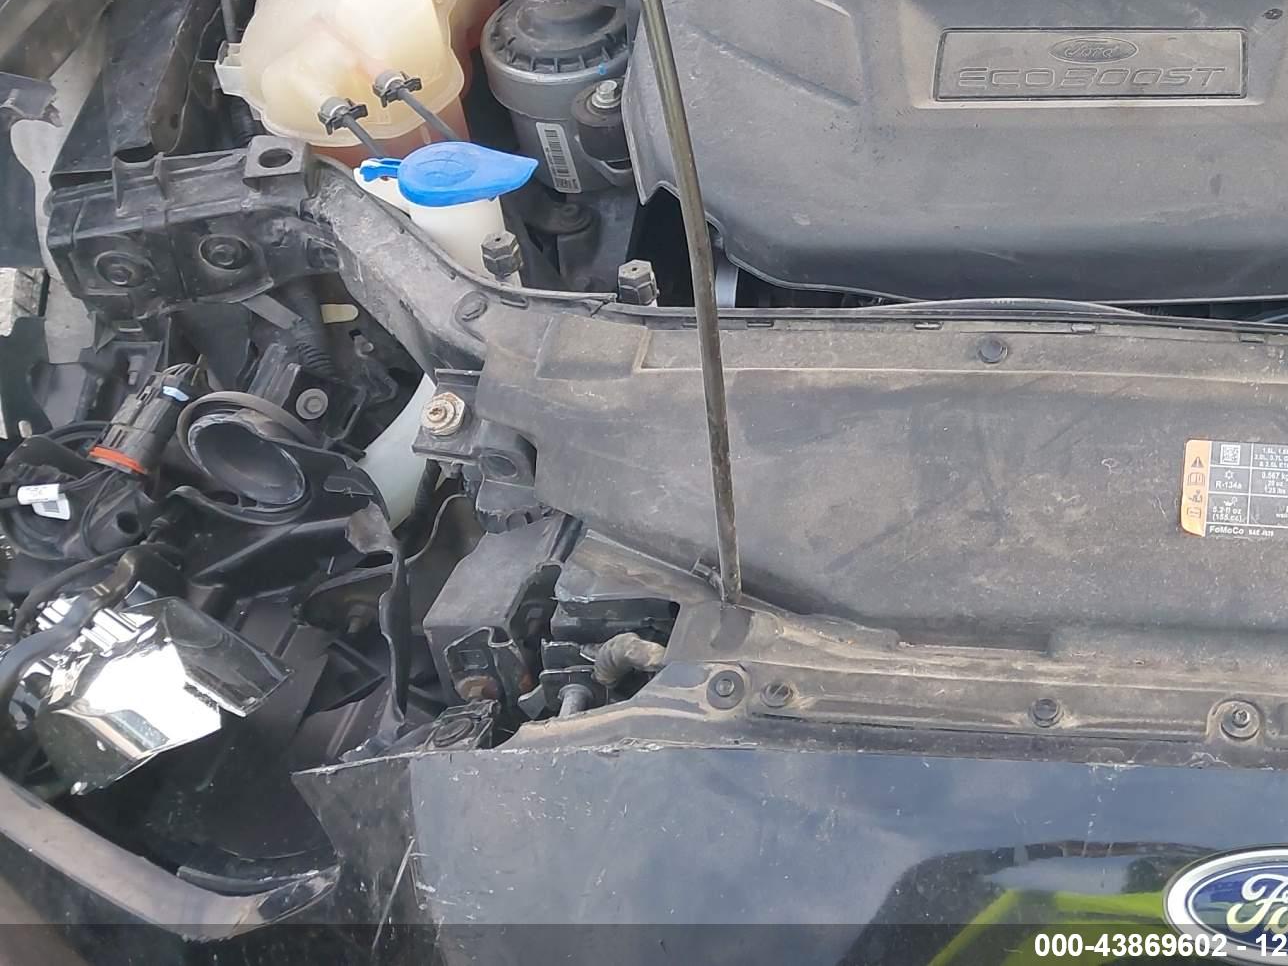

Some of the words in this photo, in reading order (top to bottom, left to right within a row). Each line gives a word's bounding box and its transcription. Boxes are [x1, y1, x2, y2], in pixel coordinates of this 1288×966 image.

[958, 67, 1227, 90] ECOBOOST
[1261, 471, 1280, 480] 0.567
[1215, 481, 1242, 490] R-134a
[1209, 525, 1245, 535] FoMoCo
